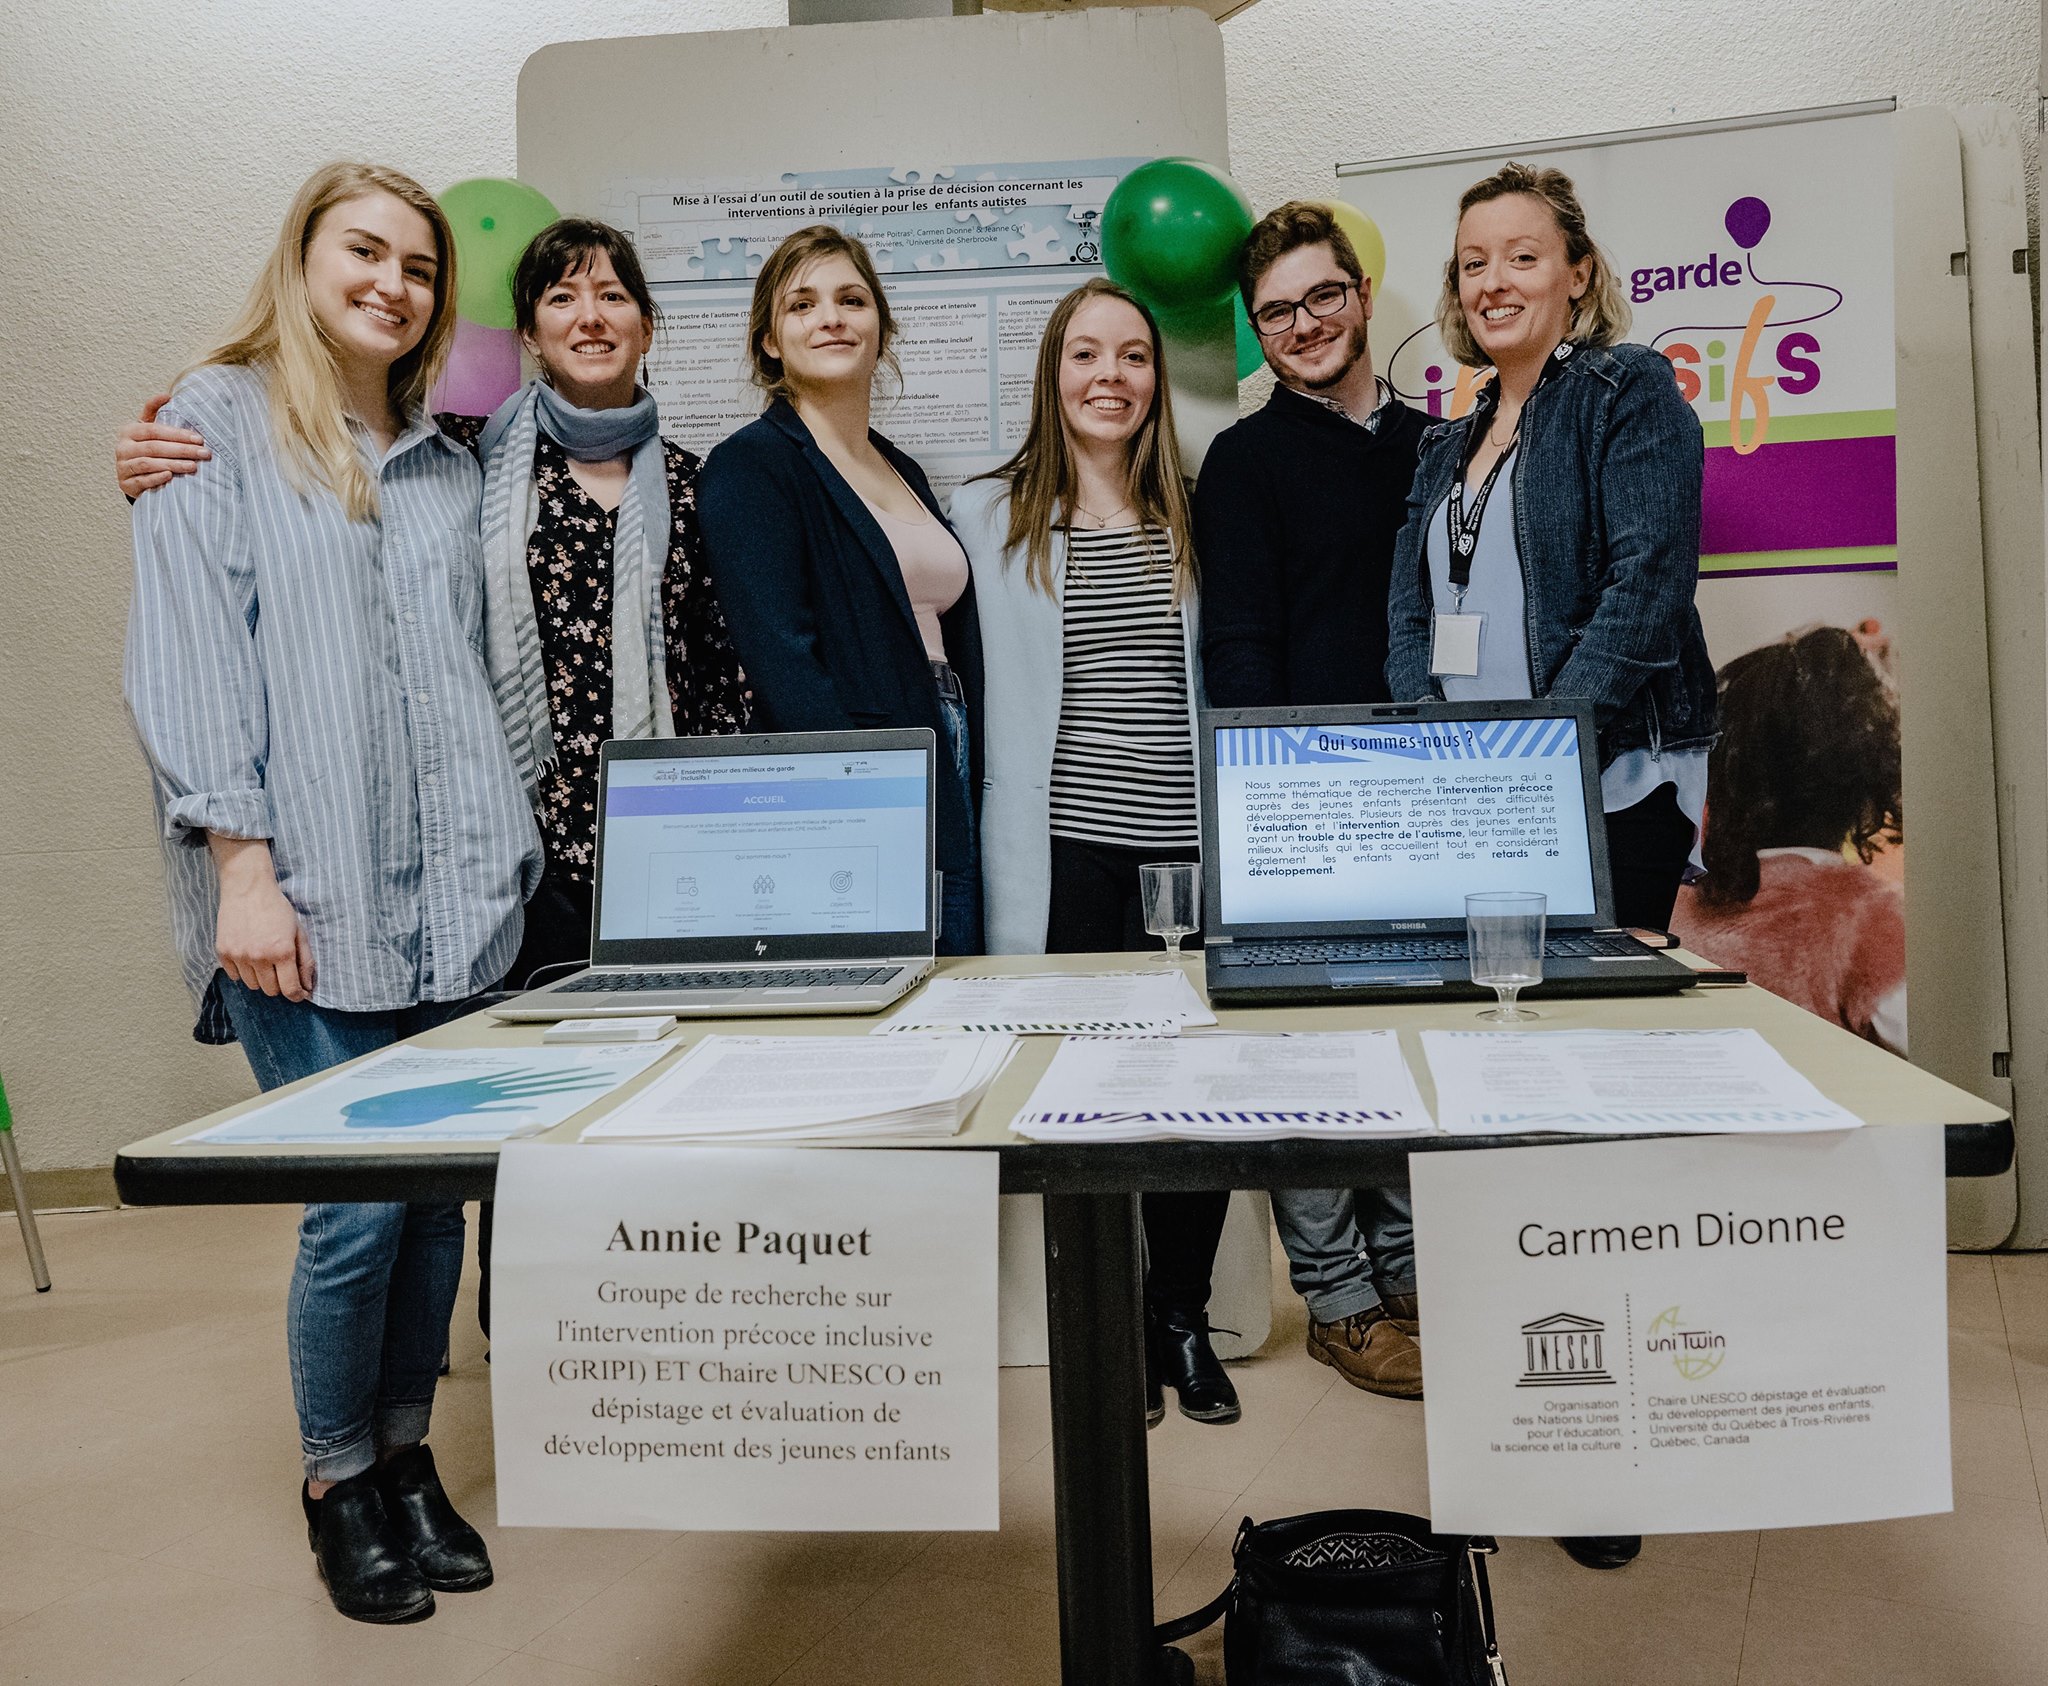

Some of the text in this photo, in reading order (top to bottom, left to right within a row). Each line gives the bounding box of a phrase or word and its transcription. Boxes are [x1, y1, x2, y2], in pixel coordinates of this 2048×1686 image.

[673, 196, 700, 205] Mise
[703, 195, 710, 204] à
[779, 191, 806, 202] outil
[810, 191, 824, 201] de
[827, 190, 871, 200] soutien
[874, 188, 881, 198] à
[884, 188, 894, 197] la
[898, 187, 925, 199] prise
[929, 185, 942, 195] de
[947, 184, 995, 194] décision
[998, 180, 1063, 192] concernant
[1067, 179, 1083, 189] les
[728, 197, 1027, 218] interventions à privilégier pour les enfants autistes
[857, 231, 885, 239] Maxime
[917, 228, 945, 236] Carmen
[1630, 253, 1743, 303] garde
[913, 302, 938, 312] précoce
[948, 301, 976, 309] intensive
[1319, 730, 1473, 752] Qui sommes-nous ?
[776, 765, 795, 773] garde
[1245, 780, 1271, 789] Nous
[1278, 780, 1321, 788] sommes
[1349, 776, 1425, 788] regroupement
[1432, 774, 1446, 784] de
[1455, 773, 1513, 783] chercheurs
[1520, 772, 1537, 784] qui
[743, 796, 786, 804] ACCUEIL
[1245, 783, 1553, 800] comme thématique de recherche l'intervention précoce
[1246, 794, 1554, 813] auprès des jeunes enfants présentant des difficultés
[1246, 810, 1354, 823] développementales.
[1360, 809, 1402, 818] Plusieurs
[1408, 808, 1422, 817] de
[1428, 809, 1446, 817] nos
[1452, 807, 1492, 816] travaux
[1497, 805, 1535, 817] portent
[1246, 815, 1557, 832] l'évaluation et l'intervention auprès des jeunes enfants
[1247, 834, 1278, 845] ayant
[1298, 832, 1335, 842] trouble
[1338, 831, 1352, 841] du
[1355, 831, 1394, 843] spectre
[1398, 830, 1412, 839] de
[1415, 829, 1465, 840] l'autisme,
[1468, 828, 1487, 837] leur
[1491, 827, 1526, 837] famille
[1529, 827, 1540, 836] et
[1544, 826, 1558, 835] les
[1247, 844, 1283, 854] milieux
[1290, 843, 1329, 853] inclusifs
[1336, 843, 1352, 854] qui
[1359, 842, 1373, 851] les
[1380, 840, 1439, 851] accueillent
[1447, 840, 1468, 849] tout
[1496, 837, 1559, 848] considérant
[1248, 847, 1559, 868] également les enfants ayant des retards de
[1248, 866, 1335, 878] développement.
[605, 1220, 873, 1265] Annie Paquet
[1518, 1213, 1846, 1256] Carmen Dionne
[598, 1280, 892, 1311] Groupe de recherche sur
[557, 1320, 933, 1351] l'intervention précoce inclusive
[1526, 1333, 1603, 1371] UNESCO
[547, 1359, 941, 1386] (GRIPI) ET Chaire UNESCO en
[1648, 1384, 1886, 1407] Chaire UNESCO dépistage et évaluation
[591, 1395, 901, 1426] dépistage et évaluation de
[1543, 1399, 1619, 1413] Organisation
[1649, 1409, 1664, 1420] du
[1666, 1405, 1758, 1421] développement
[1762, 1404, 1783, 1415] des
[1785, 1403, 1825, 1417] jeunes
[1512, 1412, 1620, 1425] des Nations Unies
[1649, 1420, 1710, 1434] Université
[1714, 1419, 1728, 1431] du
[1730, 1417, 1777, 1433] Québec
[1780, 1416, 1788, 1427] à
[1527, 1429, 1554, 1440] pour
[1649, 1434, 1750, 1450] Québec, Canada
[544, 1433, 951, 1466] développement des jeunes enfants
[1491, 1440, 1621, 1452] la science et la culture
